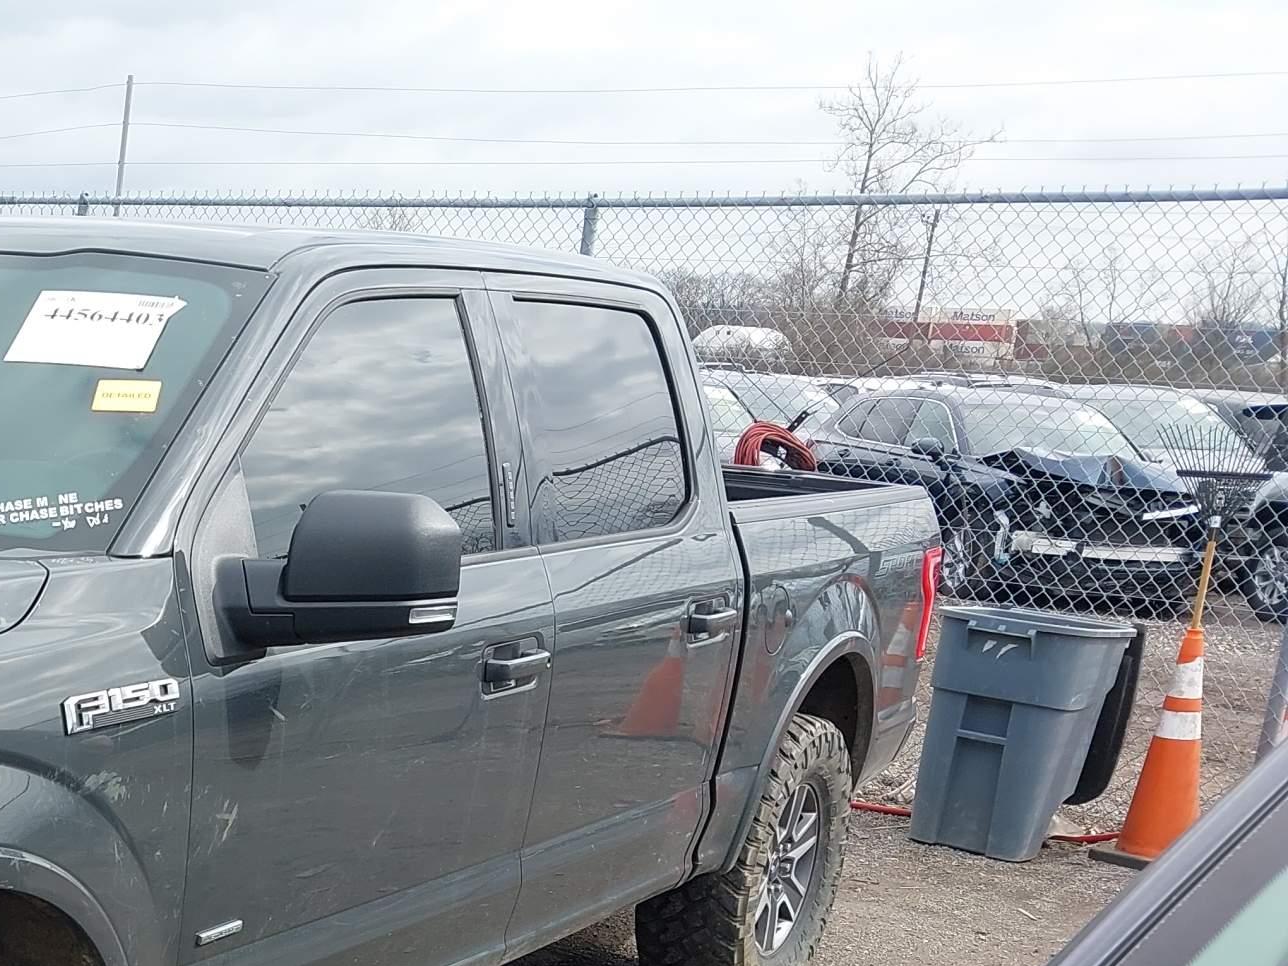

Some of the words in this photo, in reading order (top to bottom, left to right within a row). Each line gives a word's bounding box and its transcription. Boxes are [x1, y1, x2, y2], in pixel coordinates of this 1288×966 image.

[951, 311, 996, 321] Matson
[9, 506, 58, 523] CHASE
[59, 498, 124, 517] BITCHES
[153, 702, 177, 714] XLT
